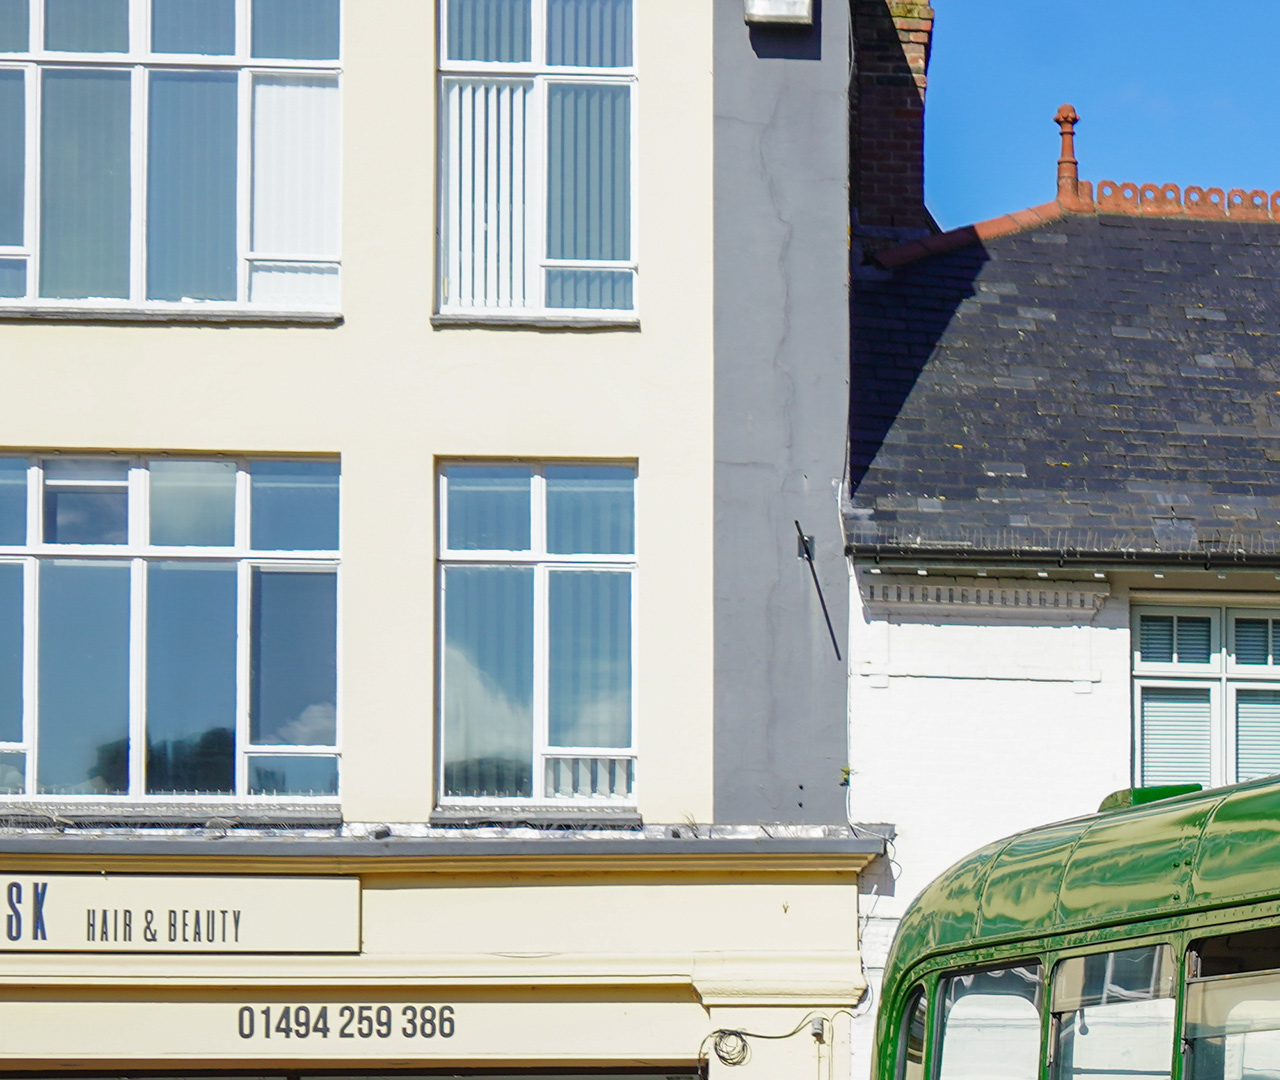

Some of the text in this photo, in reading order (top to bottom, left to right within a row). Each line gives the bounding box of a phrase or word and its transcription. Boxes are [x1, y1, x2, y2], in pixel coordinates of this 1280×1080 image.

[6, 881, 48, 942] SK
[86, 908, 241, 943] HAIR & BEAUTY
[237, 1005, 456, 1039] 01494 259 386
